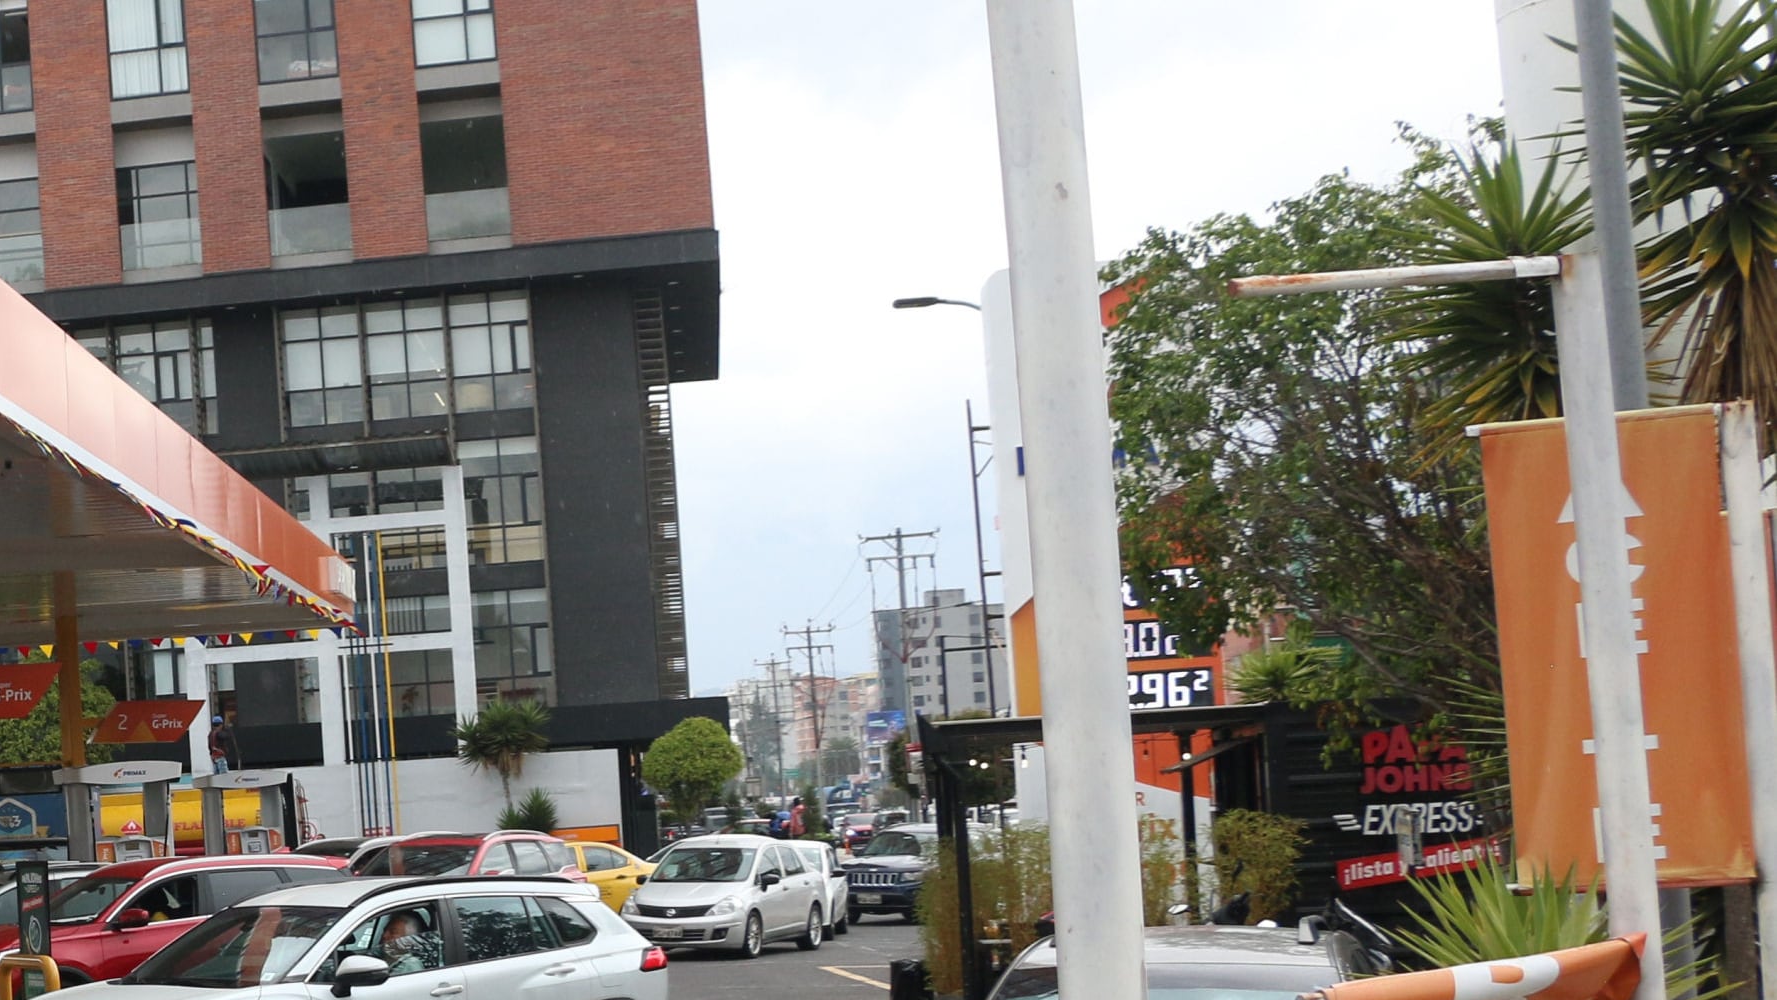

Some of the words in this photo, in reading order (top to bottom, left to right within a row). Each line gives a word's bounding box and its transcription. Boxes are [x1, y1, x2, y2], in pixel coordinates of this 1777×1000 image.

[117, 714, 128, 730] 2
[151, 718, 183, 729] G-Prix
[1360, 763, 1473, 794] JOHNS
